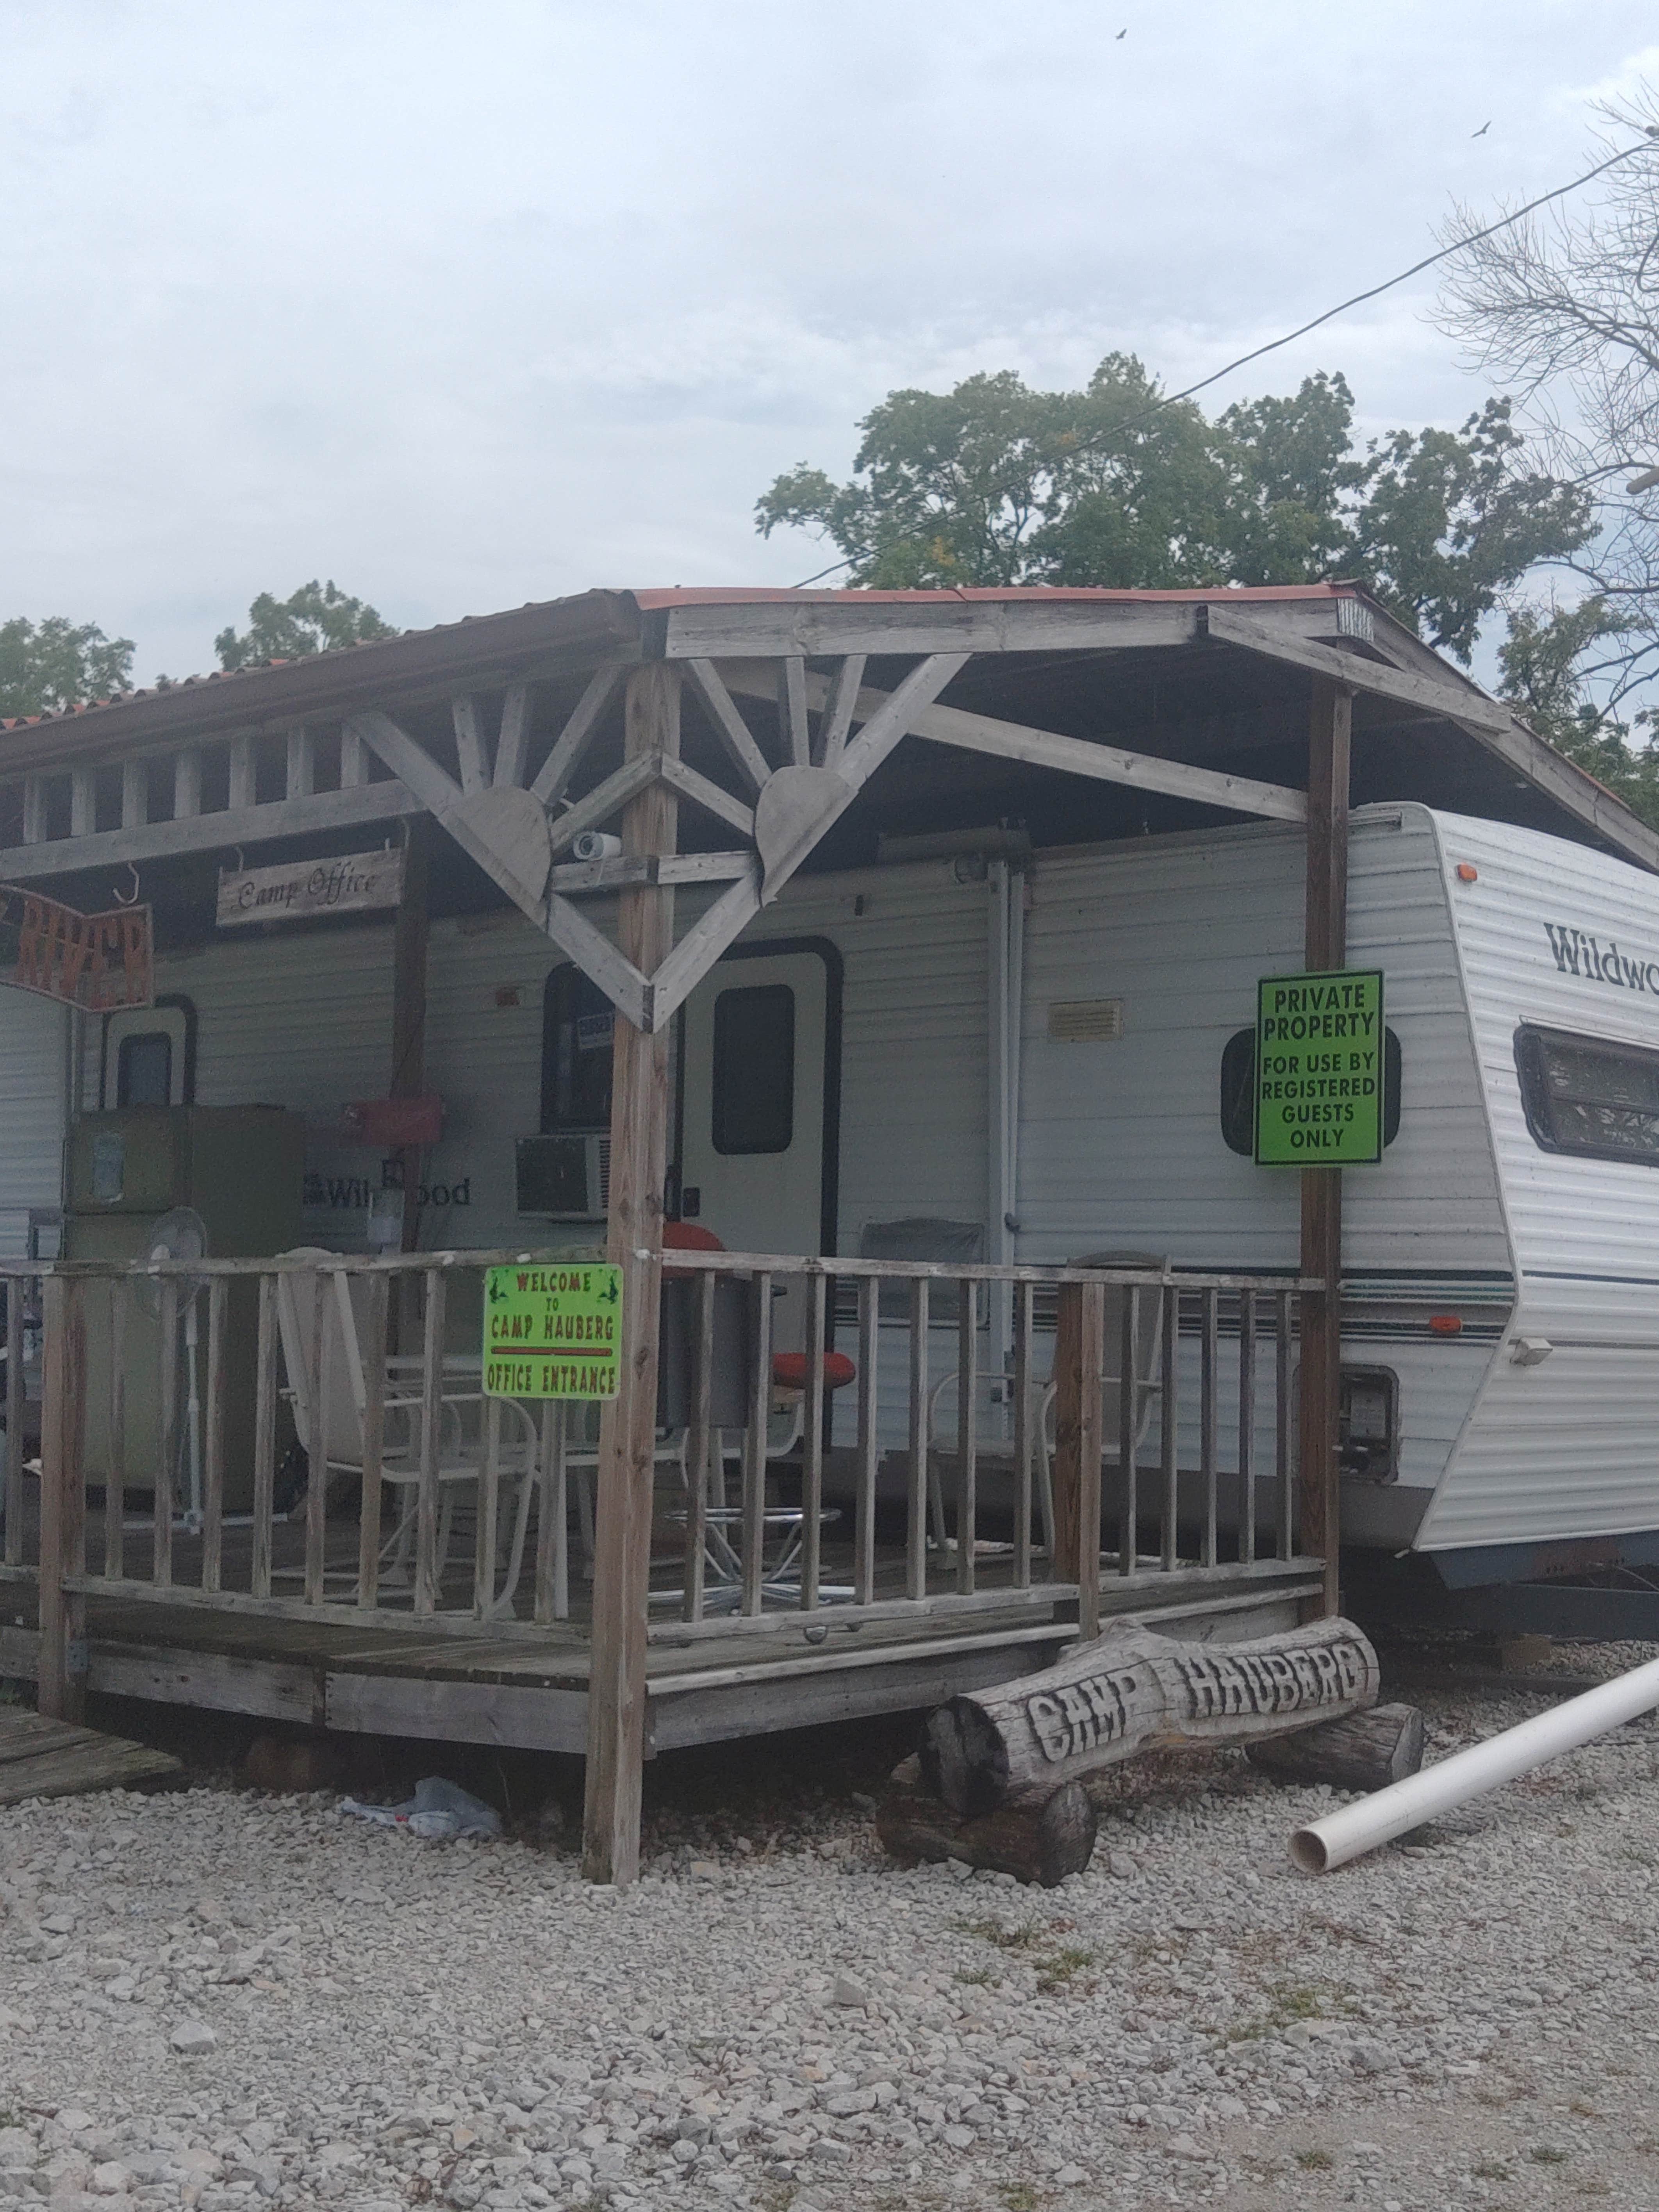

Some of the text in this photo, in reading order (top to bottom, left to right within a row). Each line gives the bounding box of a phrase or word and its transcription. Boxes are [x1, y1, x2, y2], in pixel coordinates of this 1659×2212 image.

[230, 862, 377, 909] Camp Office
[1275, 984, 1365, 1013] PRIVATE
[1264, 1011, 1375, 1041] PROPERTY
[1263, 1051, 1375, 1075] FOR USE BY
[1262, 1077, 1375, 1100] REGISTERED
[1282, 1103, 1354, 1124] GUESTS
[1290, 1129, 1344, 1148] ONLY
[516, 1272, 591, 1292] WELCOME
[546, 1297, 559, 1311] TO
[492, 1314, 613, 1340] CAMP HAUBERG
[488, 1363, 615, 1394] OFFICE ENTRANCE
[1027, 1674, 1137, 1762] CAMP
